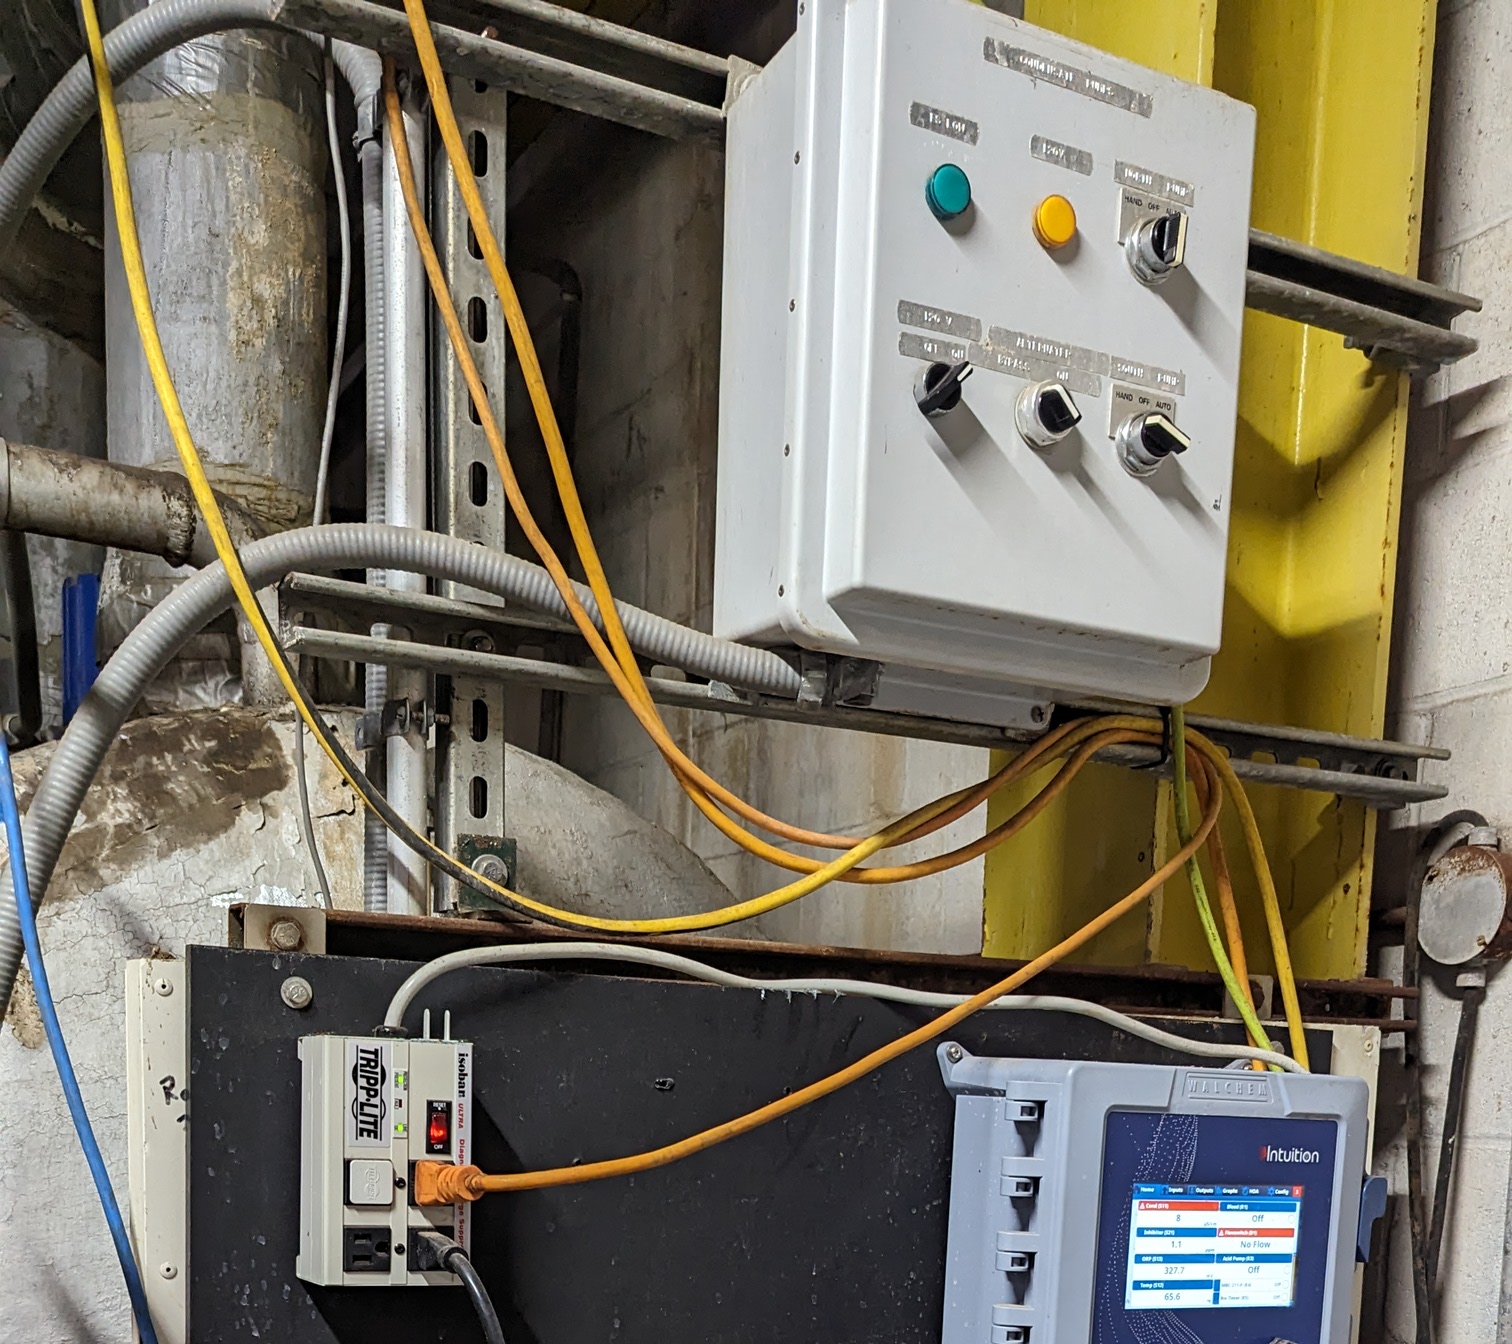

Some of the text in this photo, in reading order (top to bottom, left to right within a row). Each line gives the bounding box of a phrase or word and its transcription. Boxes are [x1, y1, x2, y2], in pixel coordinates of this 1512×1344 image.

[1124, 196, 1143, 207] HAND
[1147, 202, 1160, 212] OFF
[1115, 390, 1171, 411] HAND OFF AUTO
[1187, 1079, 1268, 1097] WALCHEM
[1266, 1145, 1319, 1163] Intuition
[1252, 1214, 1264, 1222] Off
[1171, 1240, 1182, 1248] 1.1
[1240, 1240, 1271, 1248] No Flow
[1164, 1266, 1185, 1275] 327.7
[1247, 1265, 1260, 1274] Off
[1164, 1292, 1181, 1300] 65.6
